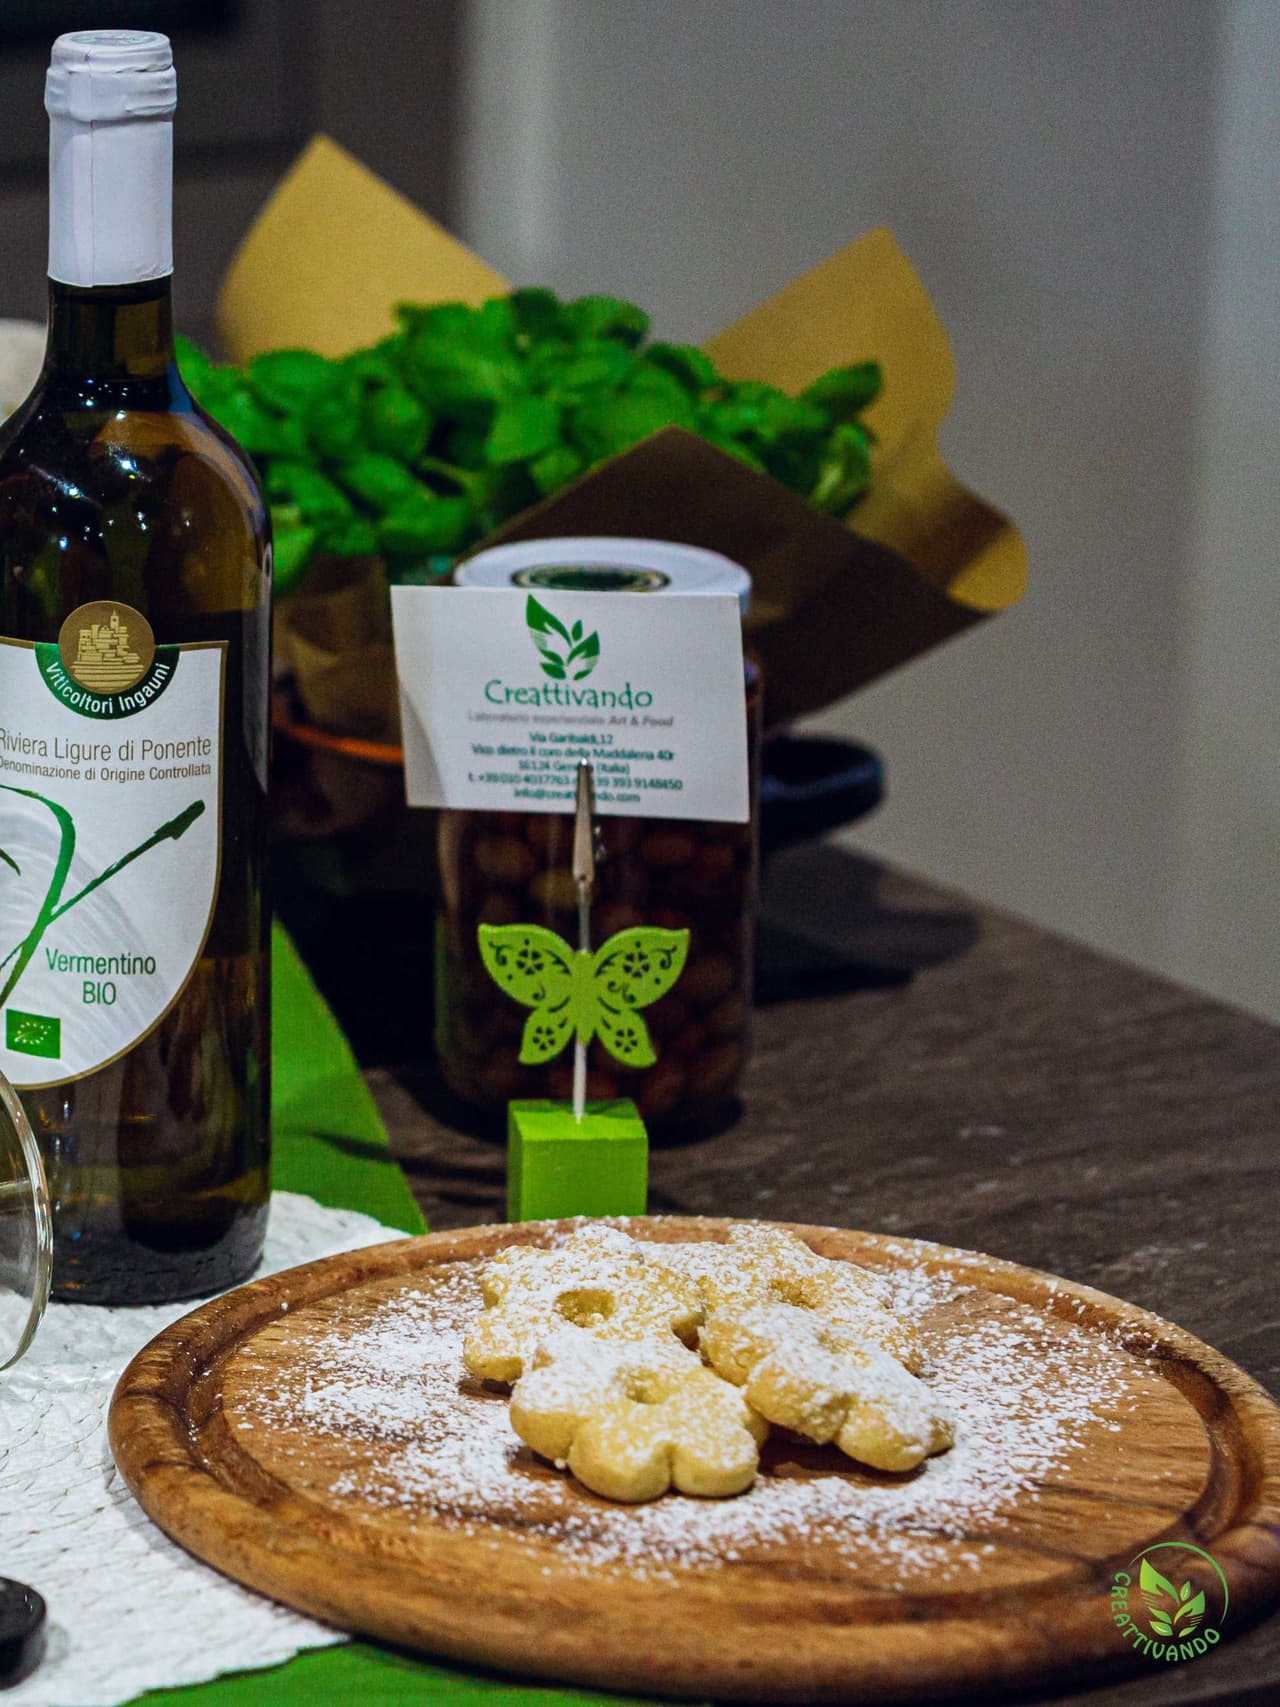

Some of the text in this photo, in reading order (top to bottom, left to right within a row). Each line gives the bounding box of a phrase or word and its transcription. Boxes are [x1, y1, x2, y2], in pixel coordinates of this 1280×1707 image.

[46, 661, 171, 714] Viticoltori Ingauni
[484, 679, 654, 711] Creattivando
[642, 715, 674, 728] Food
[54, 736, 112, 765] Ligure
[118, 739, 135, 761] di
[141, 735, 212, 761] Ponente
[528, 731, 547, 743] Via
[84, 766, 96, 781] di
[100, 766, 145, 784] Origine
[149, 763, 212, 781] Controllata
[45, 946, 157, 976] Vermentino
[82, 980, 117, 1006] BIO
